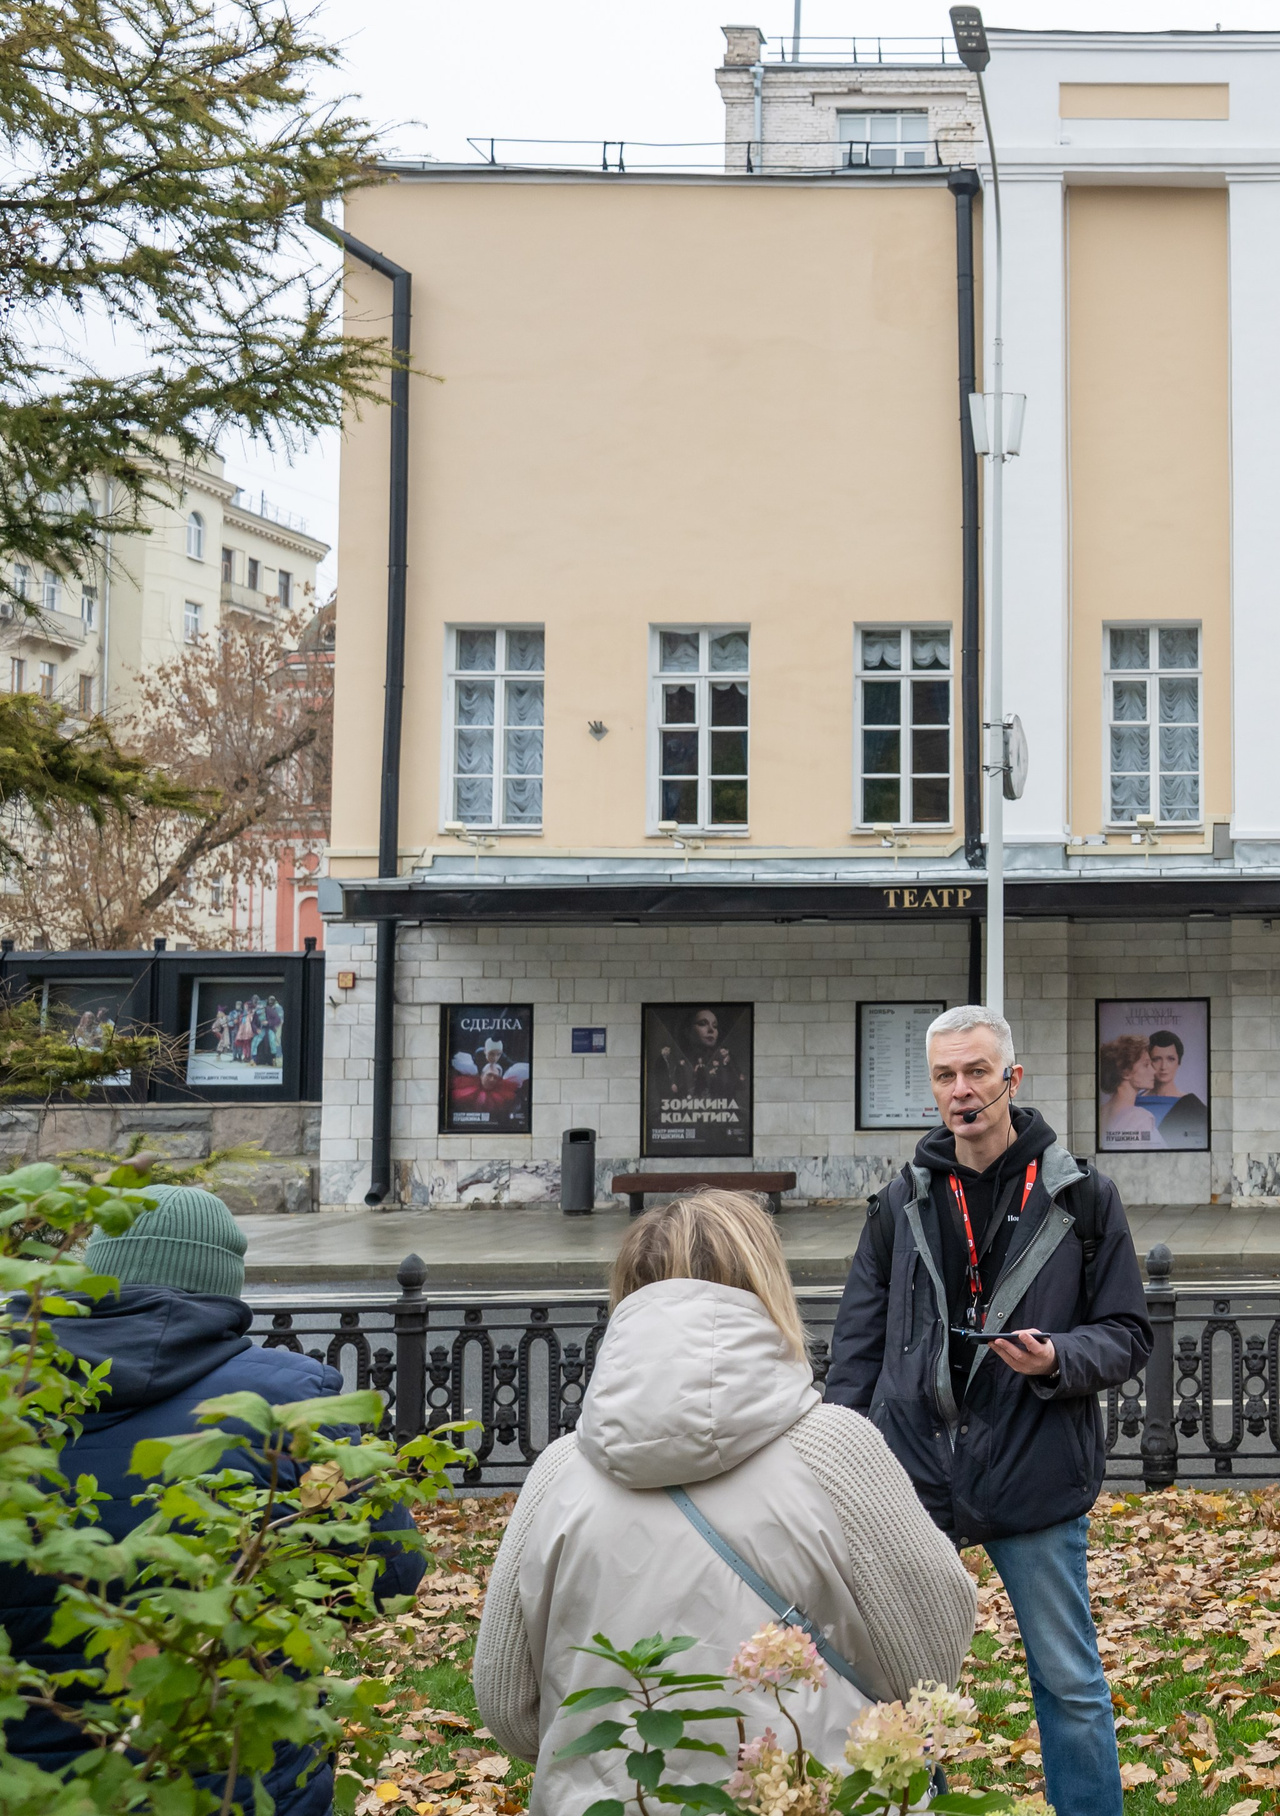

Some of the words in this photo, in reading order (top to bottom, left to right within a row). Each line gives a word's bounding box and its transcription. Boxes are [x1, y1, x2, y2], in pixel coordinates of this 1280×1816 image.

[883, 888, 972, 908] ТЕАТР
[460, 1018, 522, 1032] СДЕЛКА
[661, 1094, 740, 1111] ЗОЙКИНА
[661, 1112, 740, 1123] КВАРТИРА
